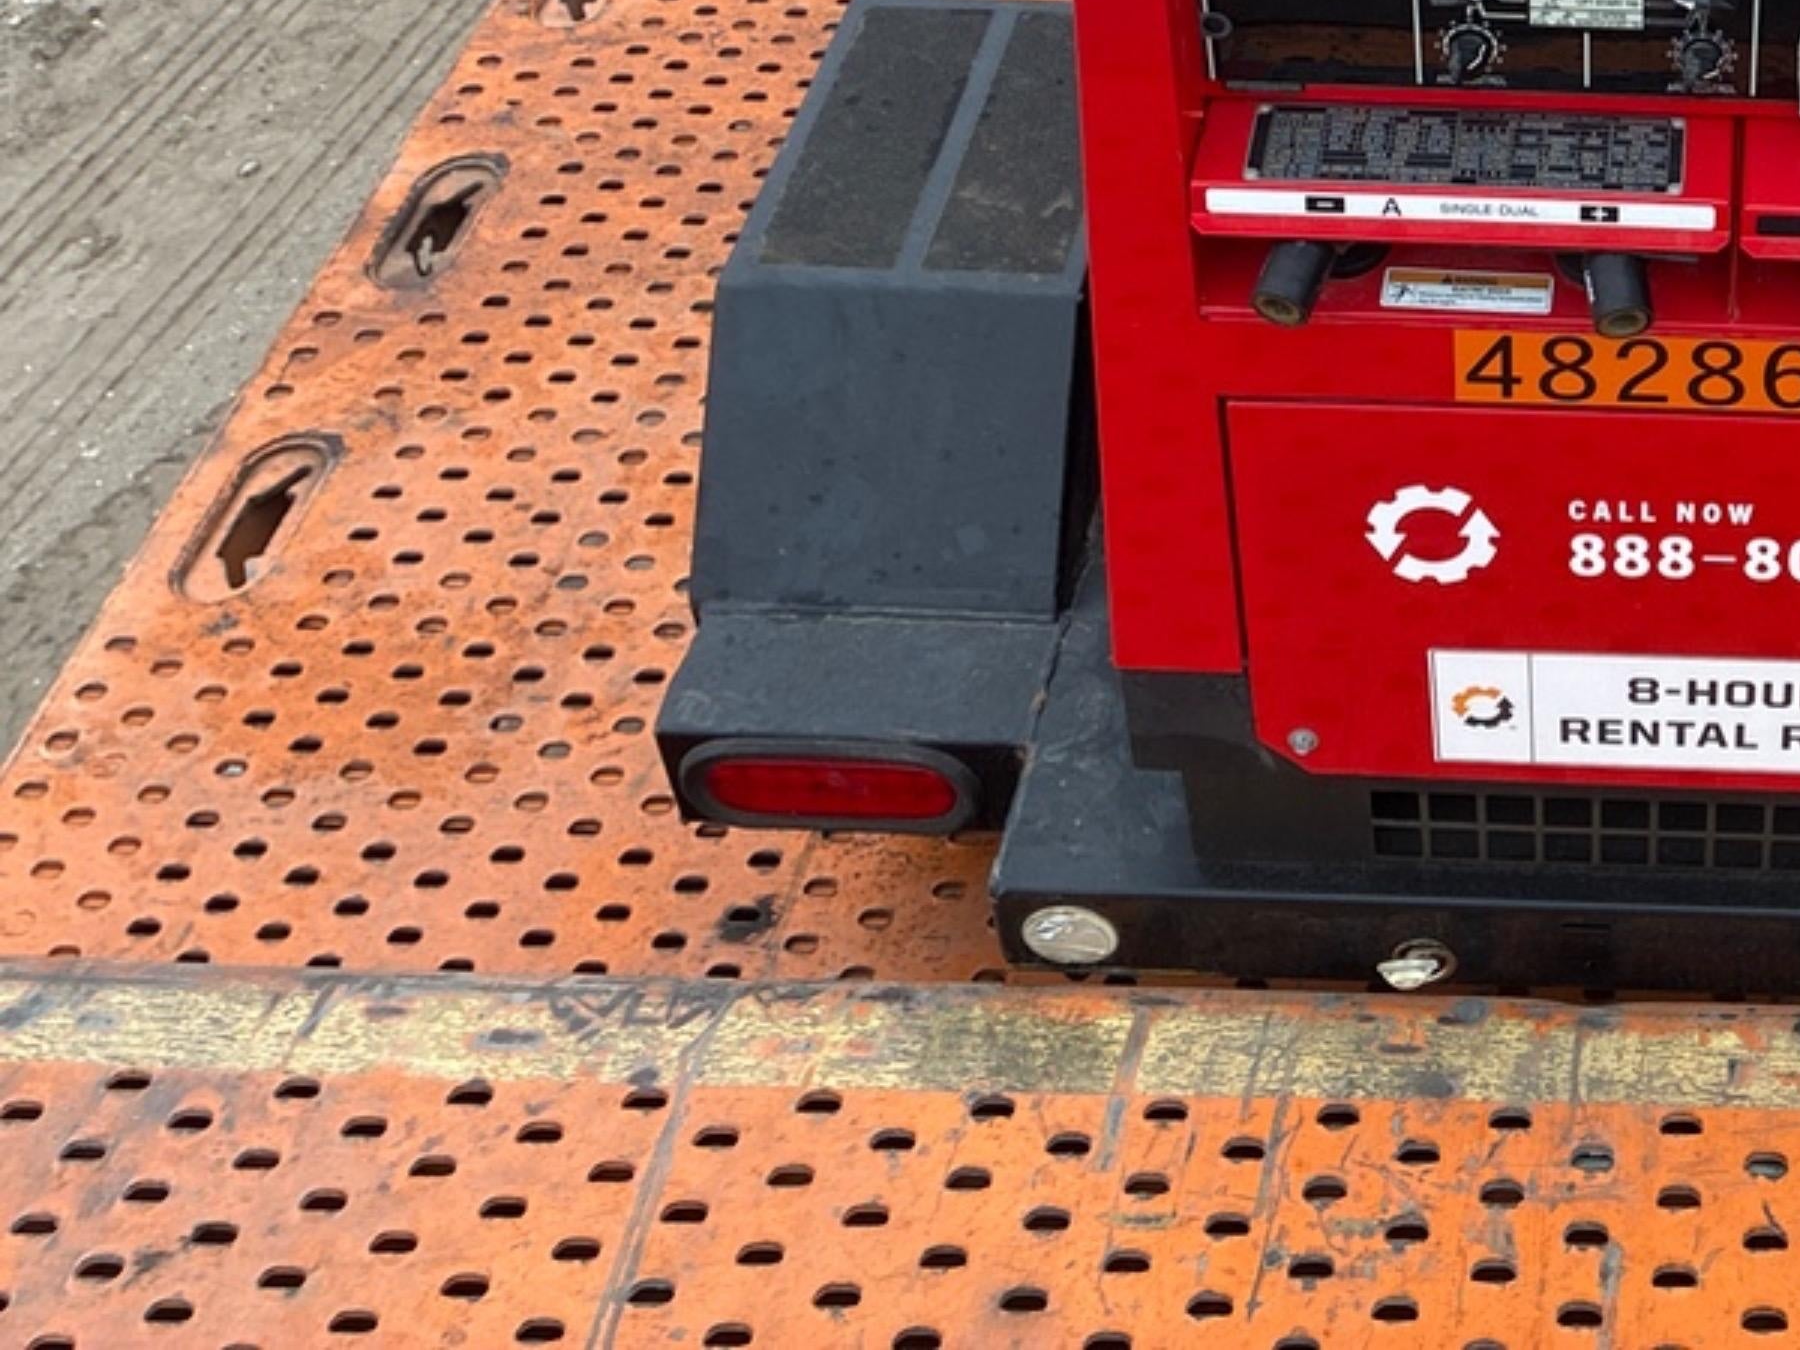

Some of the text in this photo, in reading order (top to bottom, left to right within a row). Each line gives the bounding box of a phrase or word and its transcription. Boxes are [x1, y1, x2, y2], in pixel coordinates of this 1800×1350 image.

[1381, 197, 1539, 217] A SINGLE DUAL
[1567, 499, 1756, 525] CALL NOW
[1559, 718, 1759, 751] RENTAL
